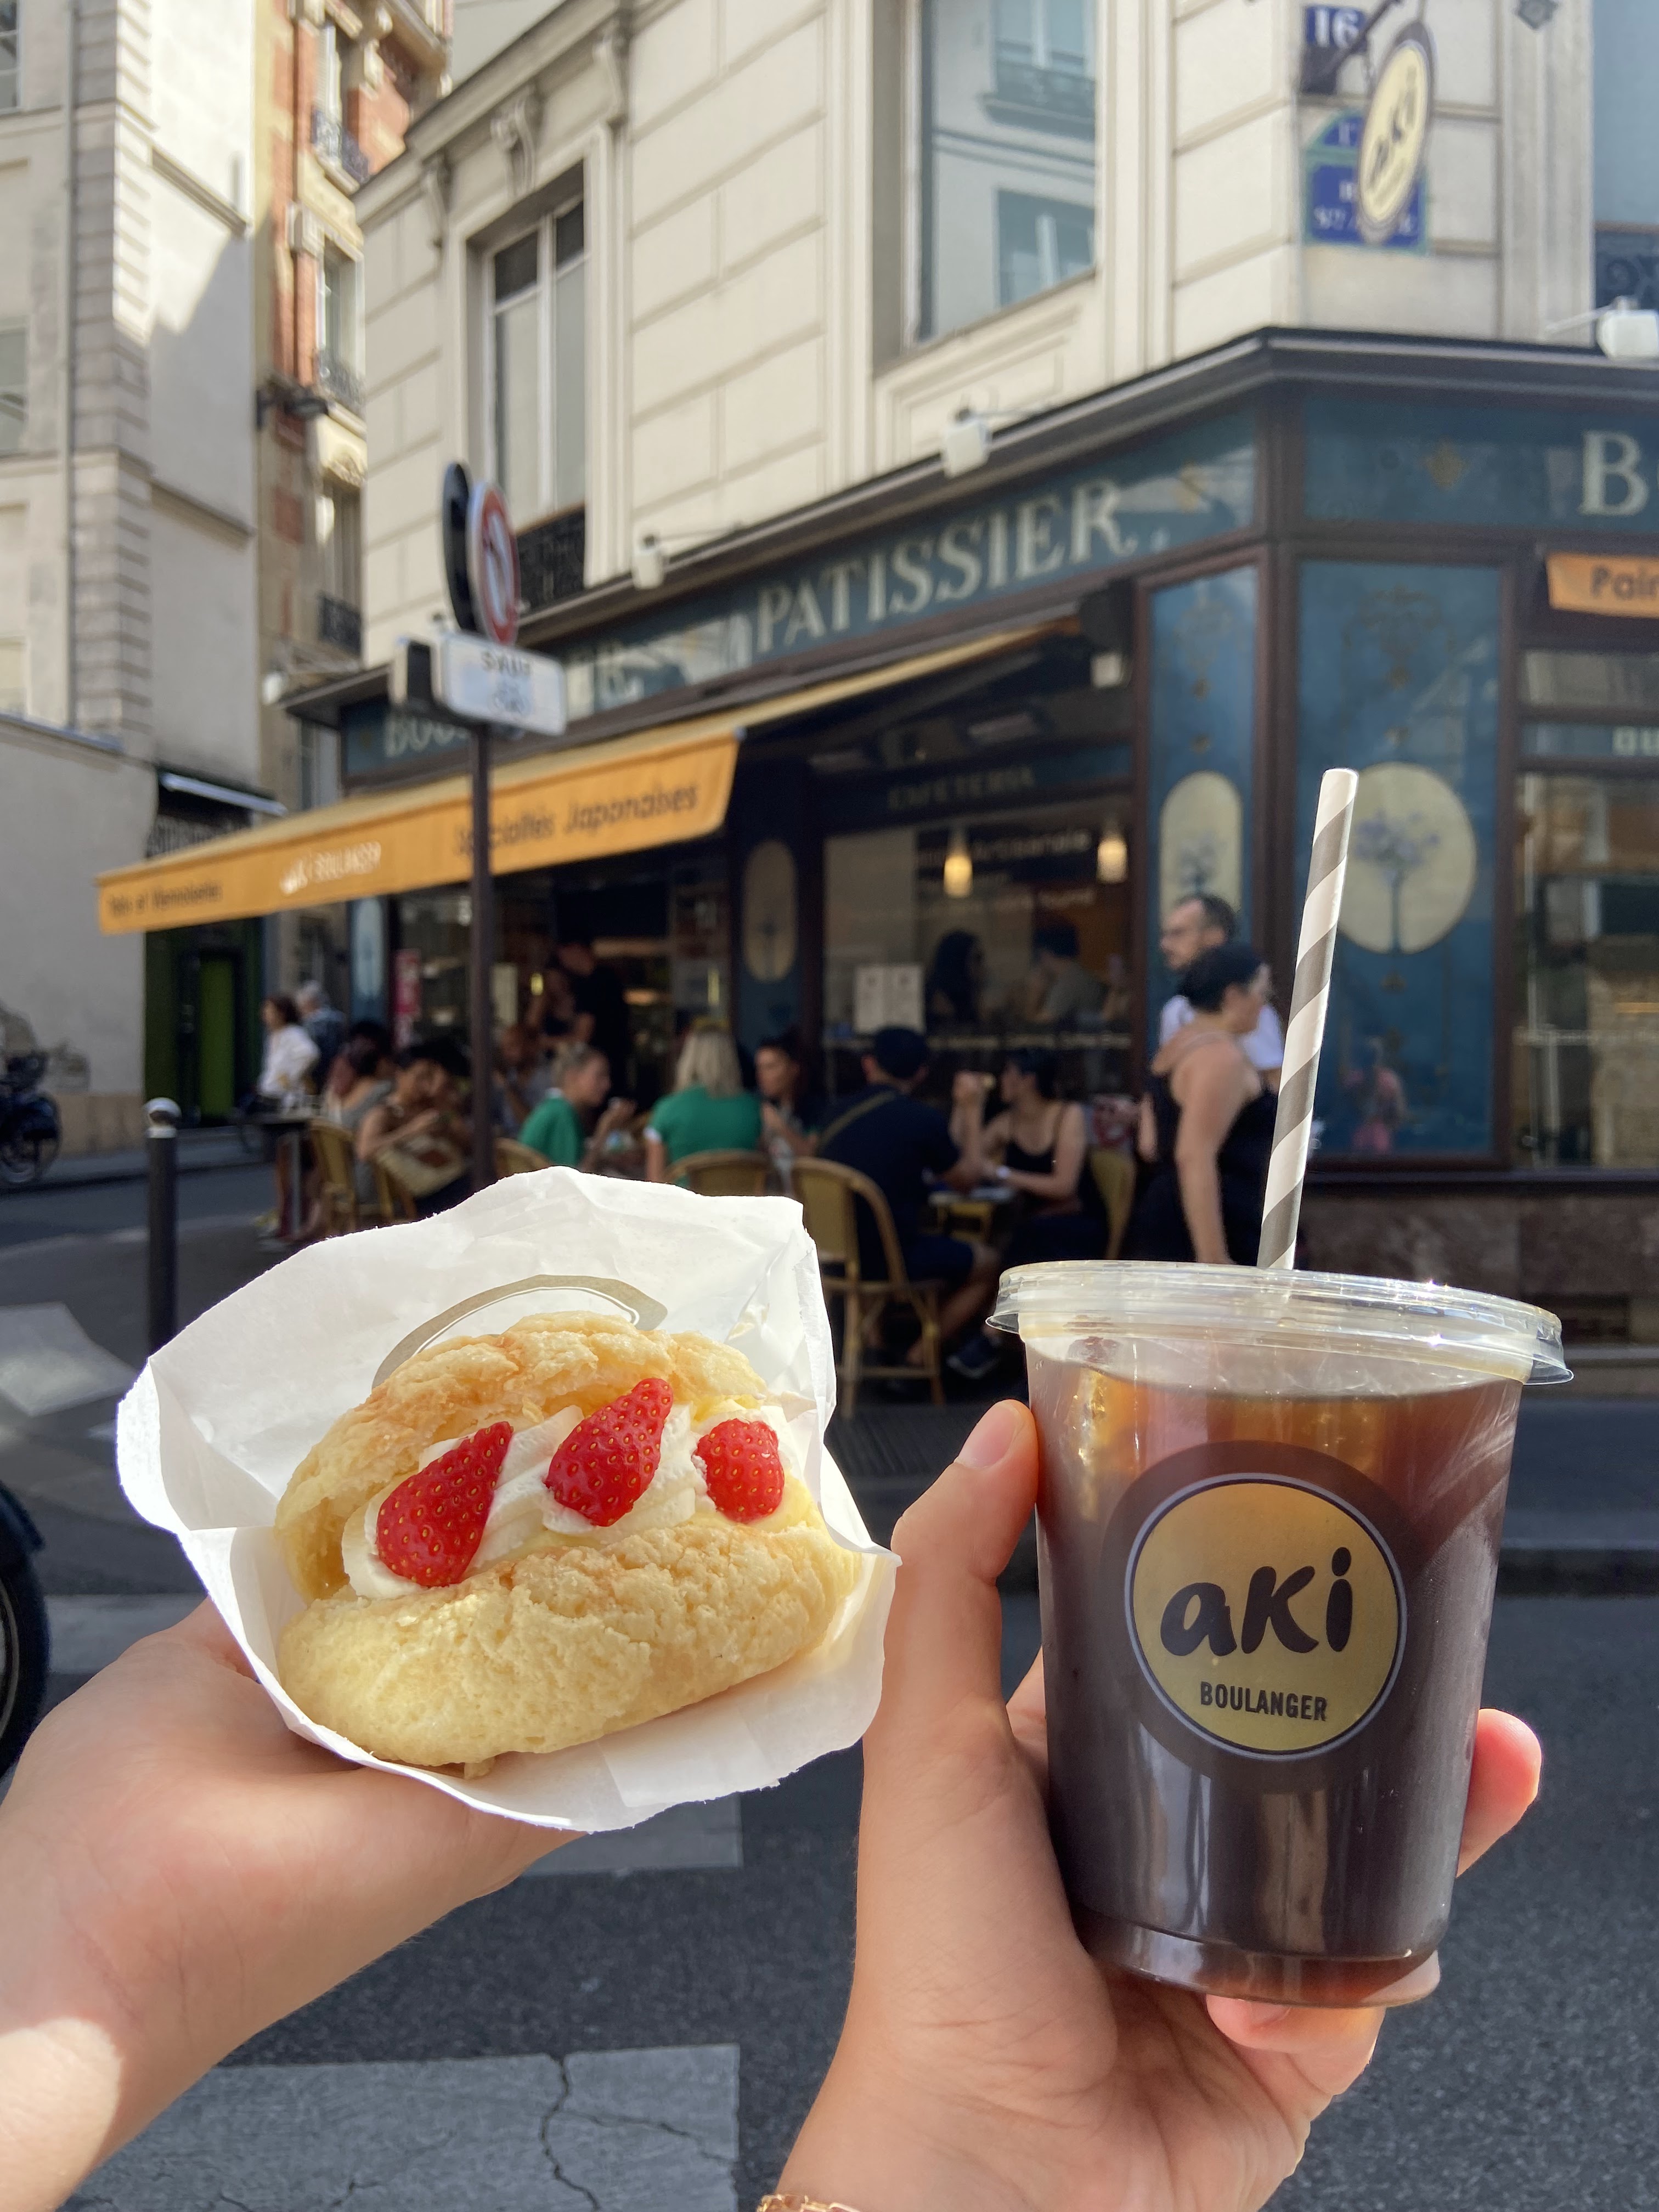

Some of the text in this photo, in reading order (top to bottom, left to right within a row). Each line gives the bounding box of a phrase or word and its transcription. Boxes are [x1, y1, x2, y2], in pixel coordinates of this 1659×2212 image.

[1578, 428, 1659, 517] B
[756, 478, 1138, 652] PATISSIER
[1200, 1681, 1328, 1722] BOULANGER
